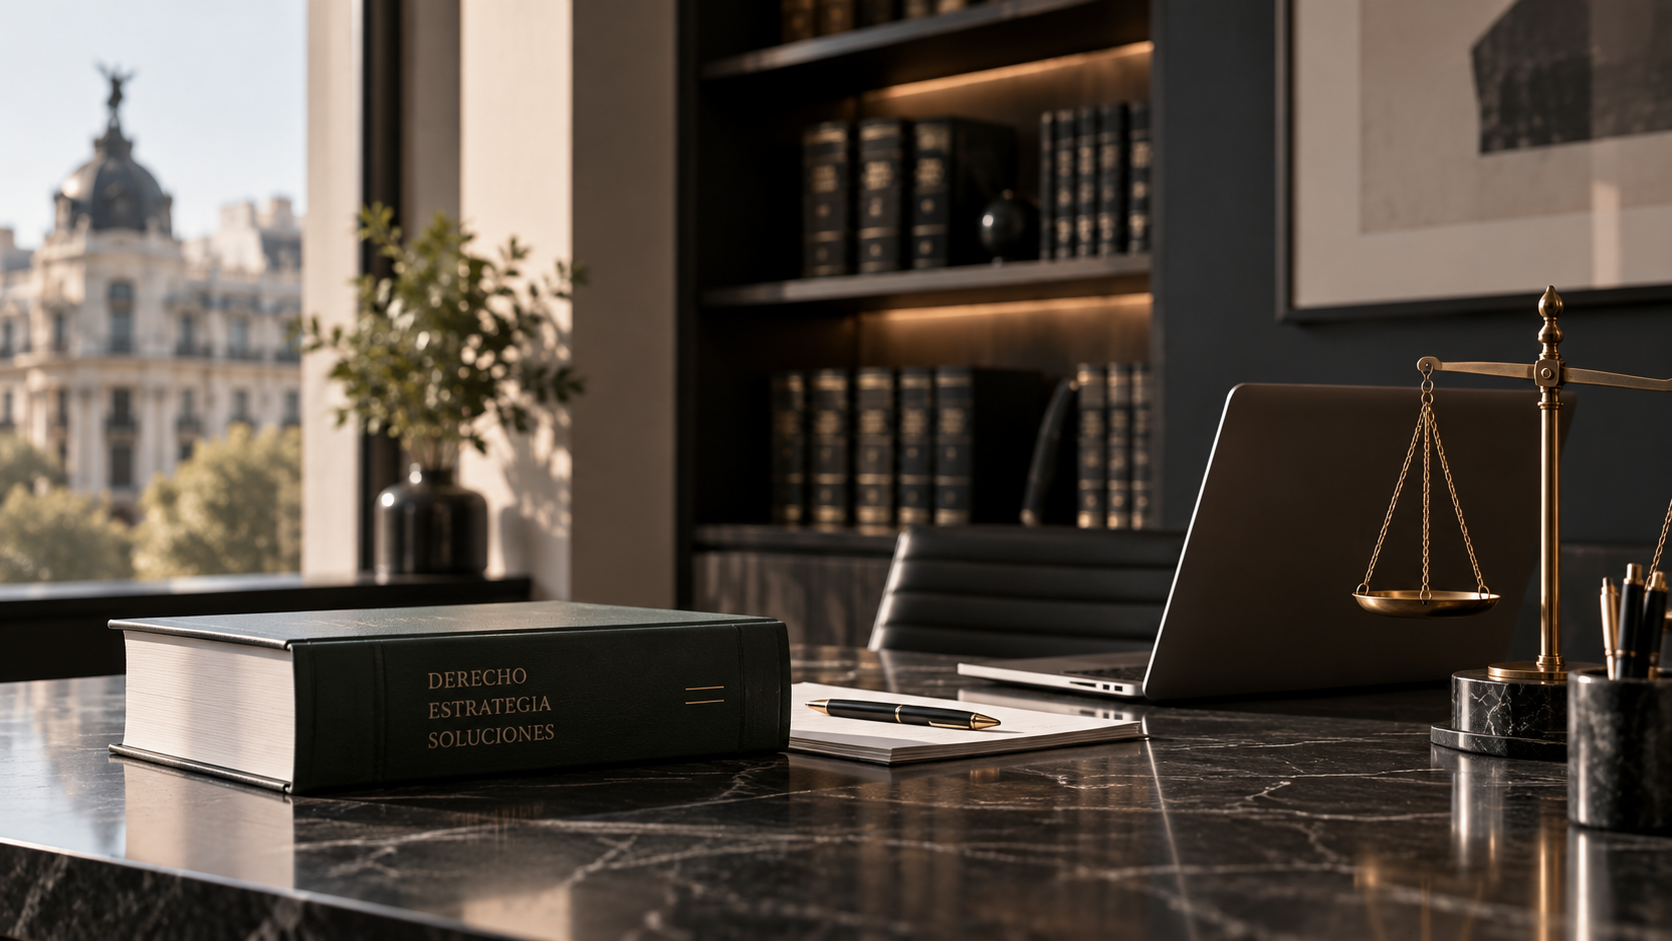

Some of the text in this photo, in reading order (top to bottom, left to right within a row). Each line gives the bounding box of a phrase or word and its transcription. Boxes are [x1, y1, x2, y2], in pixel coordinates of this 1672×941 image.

[428, 667, 527, 690] DERECHO
[428, 695, 552, 719] ESTRATEGIA
[428, 723, 555, 749] SOLUCIONES
